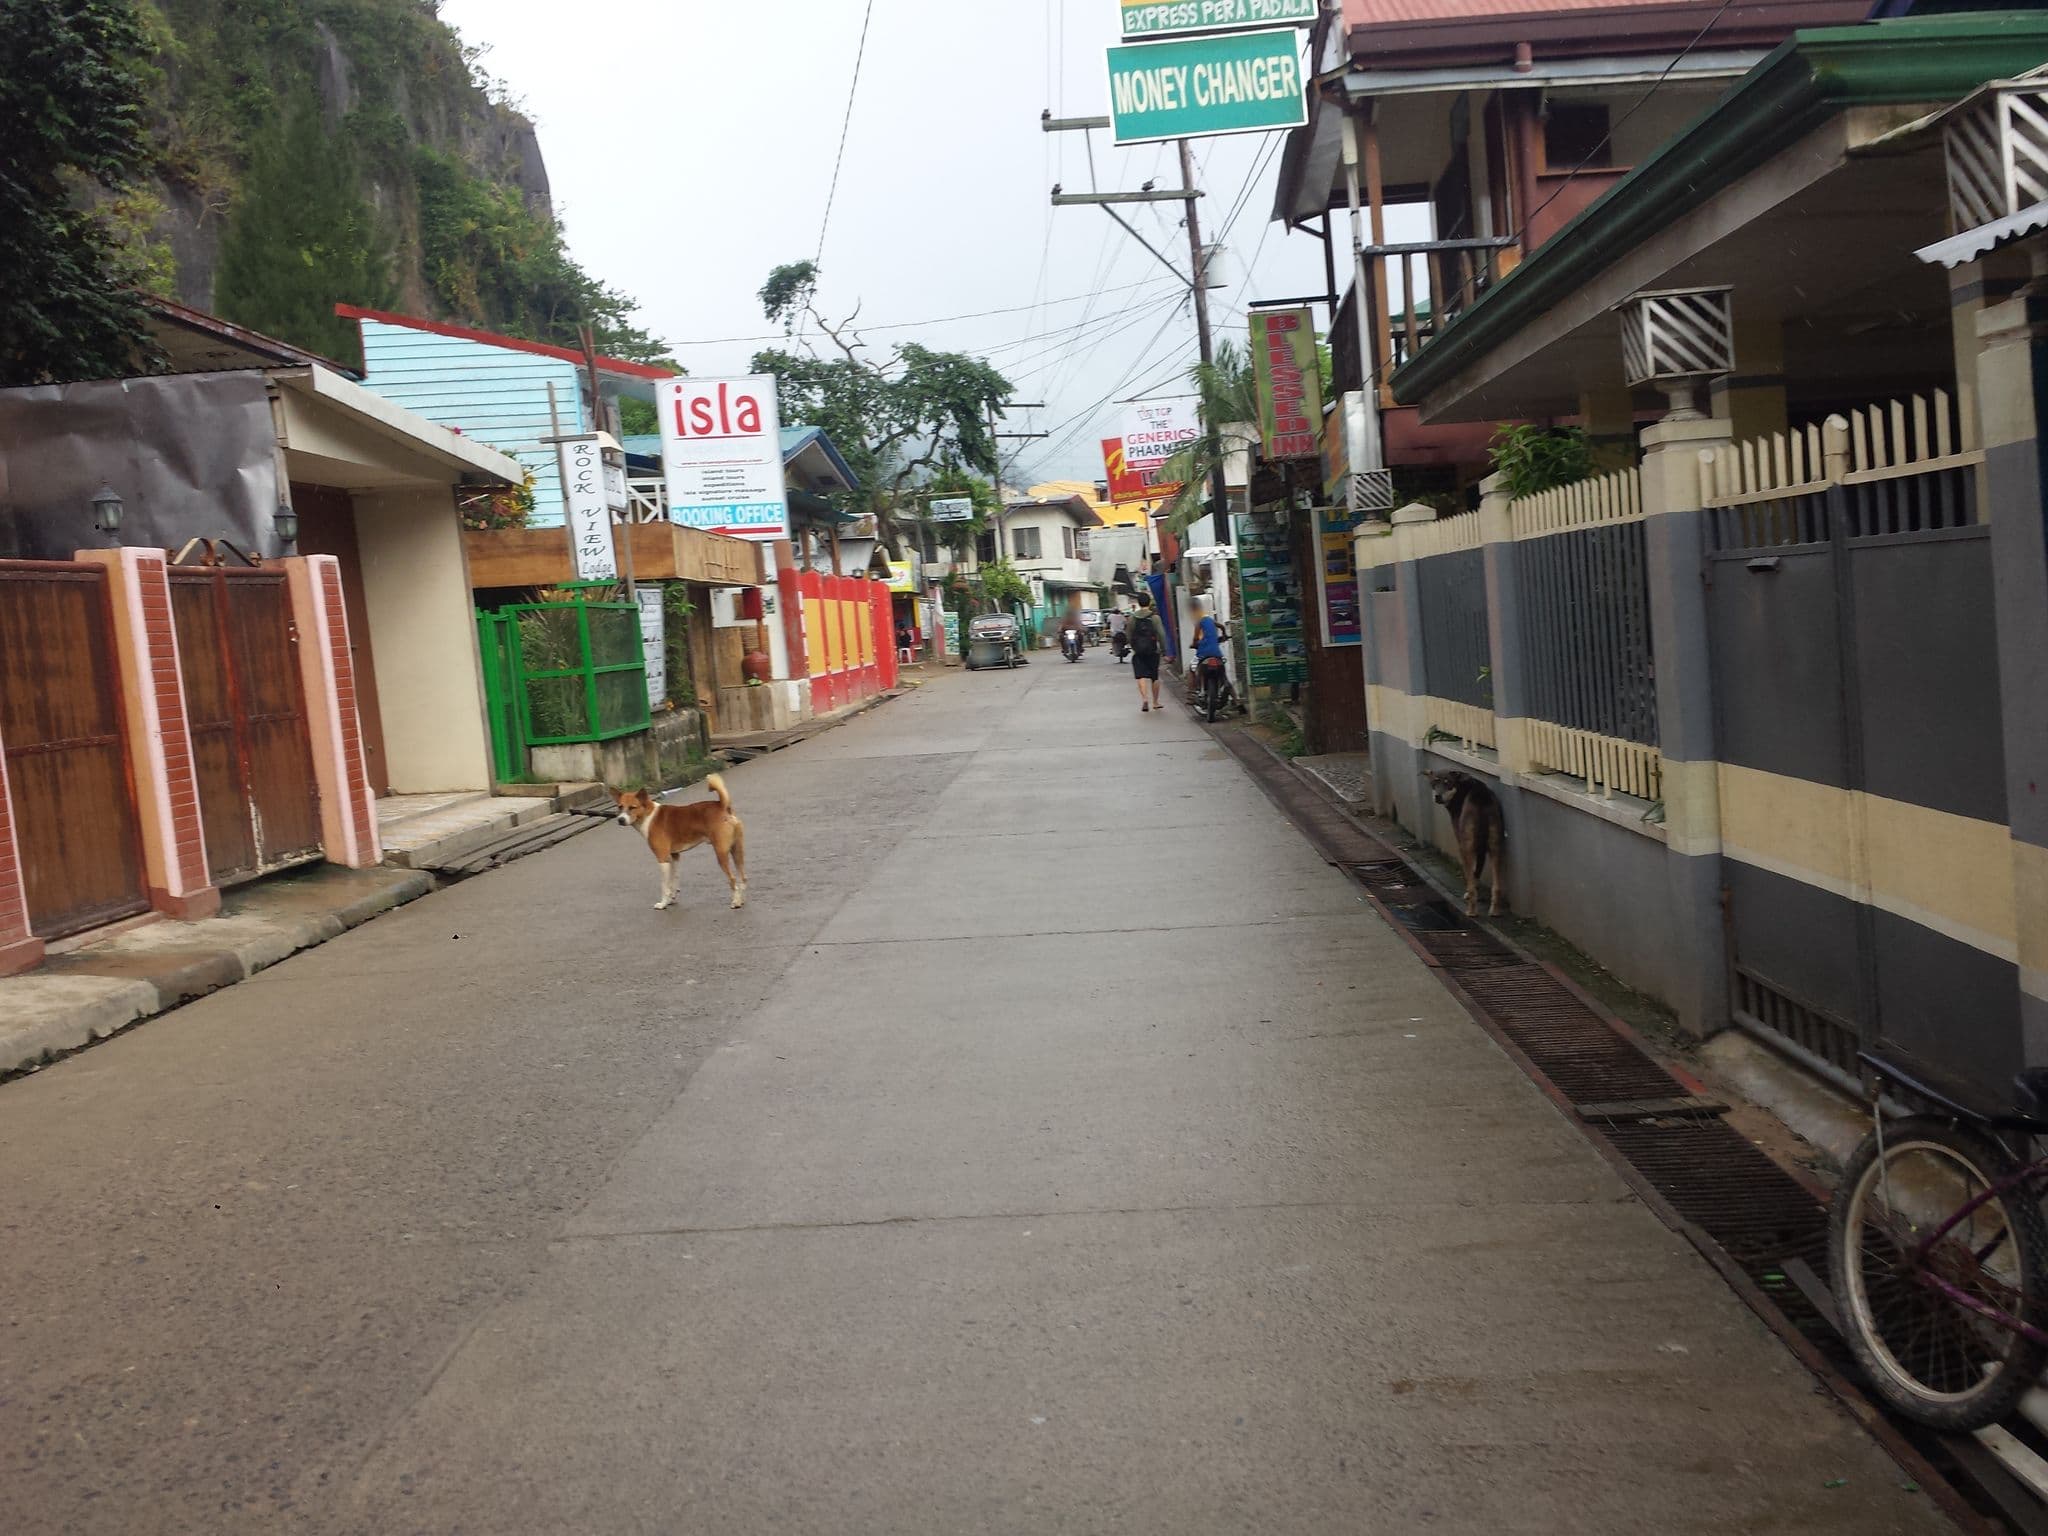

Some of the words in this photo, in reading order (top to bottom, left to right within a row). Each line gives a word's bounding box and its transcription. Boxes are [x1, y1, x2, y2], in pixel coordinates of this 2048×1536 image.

[1125, 3, 1198, 31] EXPRESS
[1202, 0, 1246, 24] PERA
[1250, 0, 1312, 19] PADALA
[1113, 66, 1189, 114] MONEY
[1193, 55, 1299, 106] CHANGER
[1265, 314, 1311, 433] BLESSED
[674, 382, 762, 437] isla
[1150, 420, 1169, 430] THE
[1127, 428, 1196, 444] GENERICS
[1271, 434, 1315, 456] INN
[573, 444, 596, 494] ROCK
[580, 507, 606, 557] VIEW
[672, 505, 732, 525] BOOKING
[735, 503, 782, 523] OFFICE
